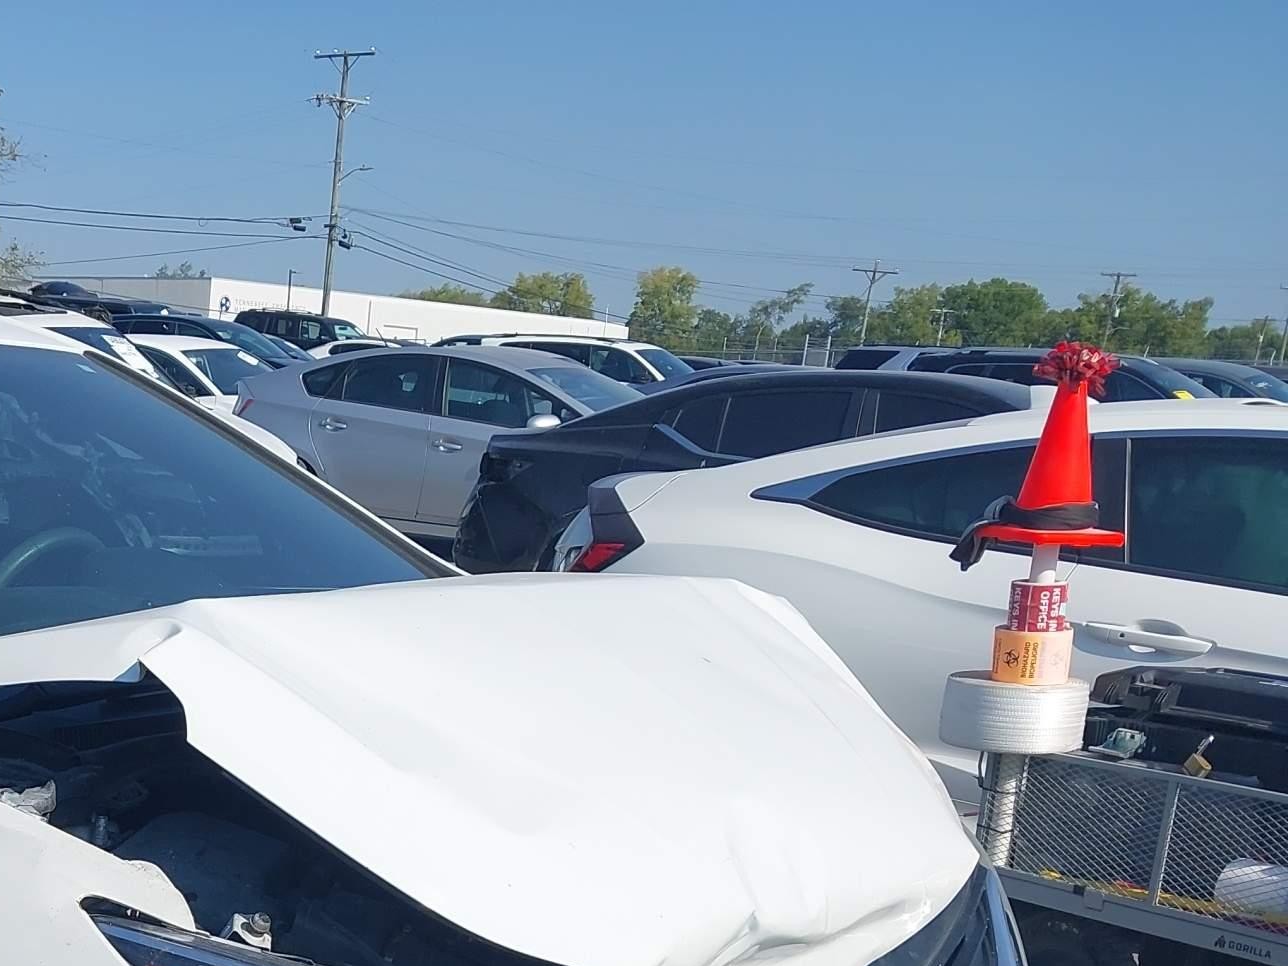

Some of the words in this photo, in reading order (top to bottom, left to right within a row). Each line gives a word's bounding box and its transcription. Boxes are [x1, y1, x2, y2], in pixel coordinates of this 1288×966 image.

[1012, 587, 1022, 616] KEYS
[1037, 591, 1050, 630] OFFICE
[1050, 587, 1061, 617] KEYS
[1020, 641, 1031, 678] BIOHAZARD
[1228, 940, 1272, 959] GORILLA
